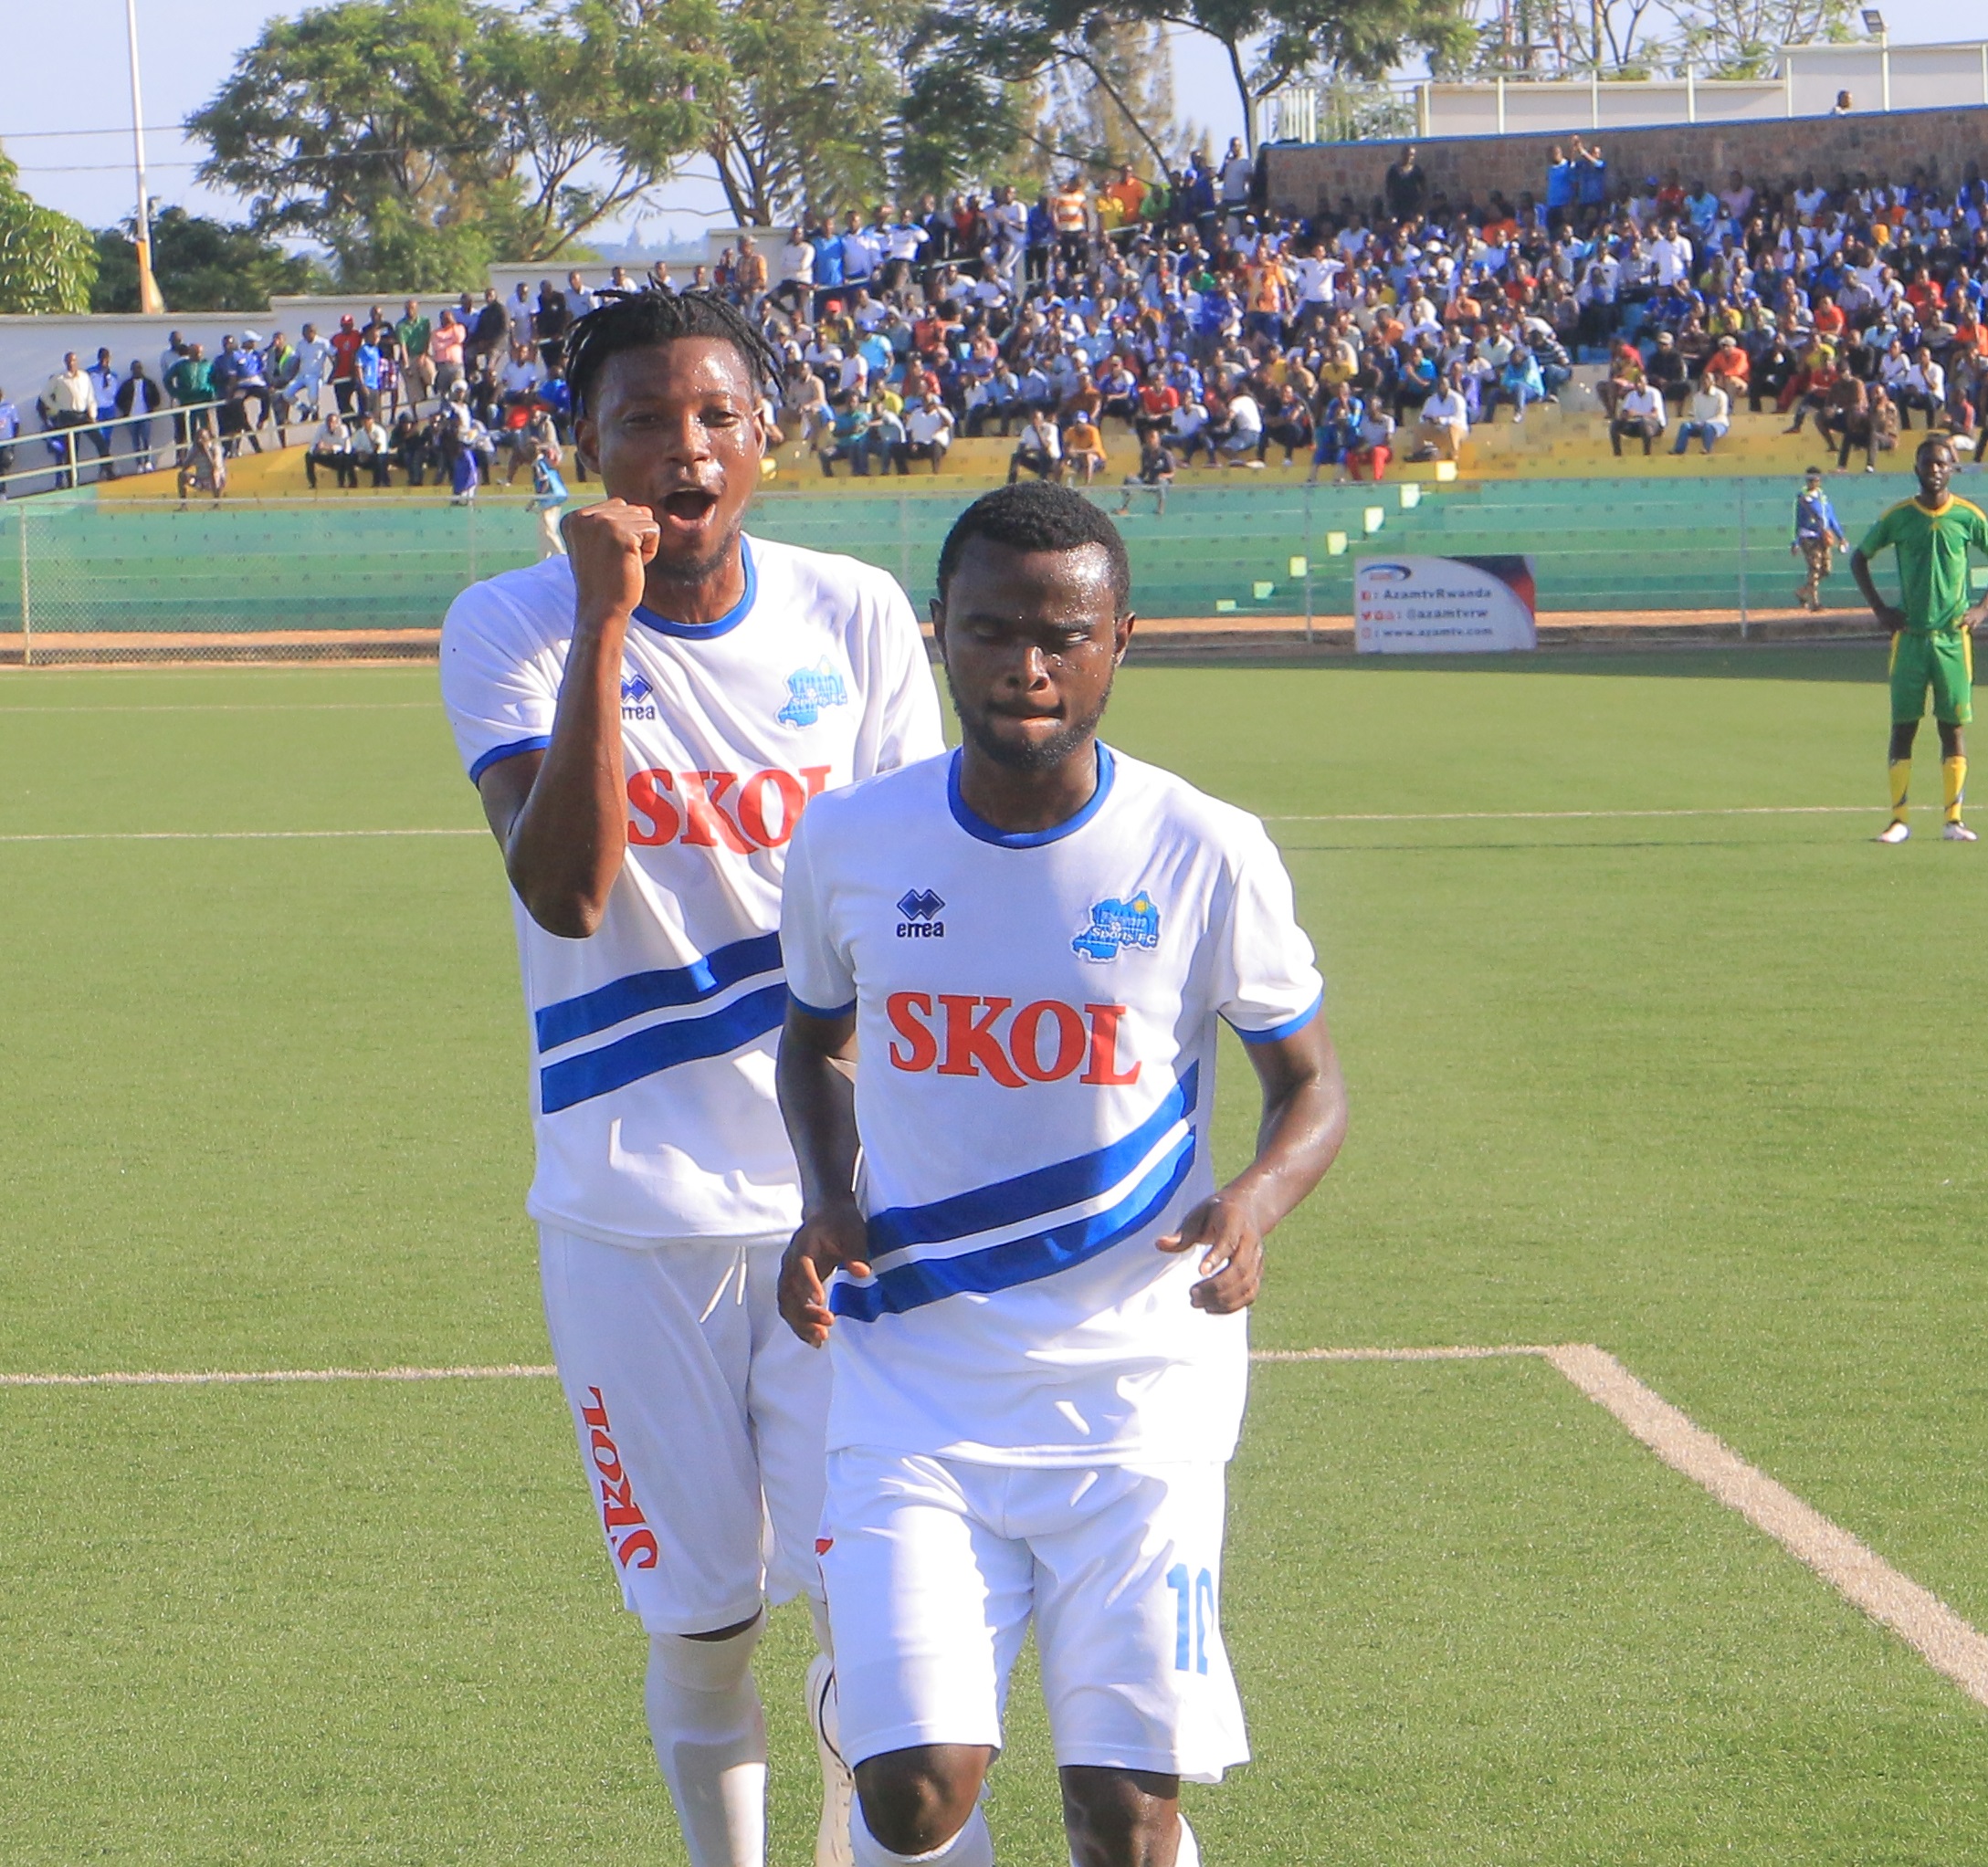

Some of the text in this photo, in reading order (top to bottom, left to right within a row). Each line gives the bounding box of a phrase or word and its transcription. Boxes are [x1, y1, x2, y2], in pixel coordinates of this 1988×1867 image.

[1383, 626, 1493, 637] www.azamtv.com
[621, 706, 656, 720] rrea
[1138, 931, 1157, 946] FC
[885, 991, 1141, 1088] SKOL
[579, 1385, 659, 1569] SKOL
